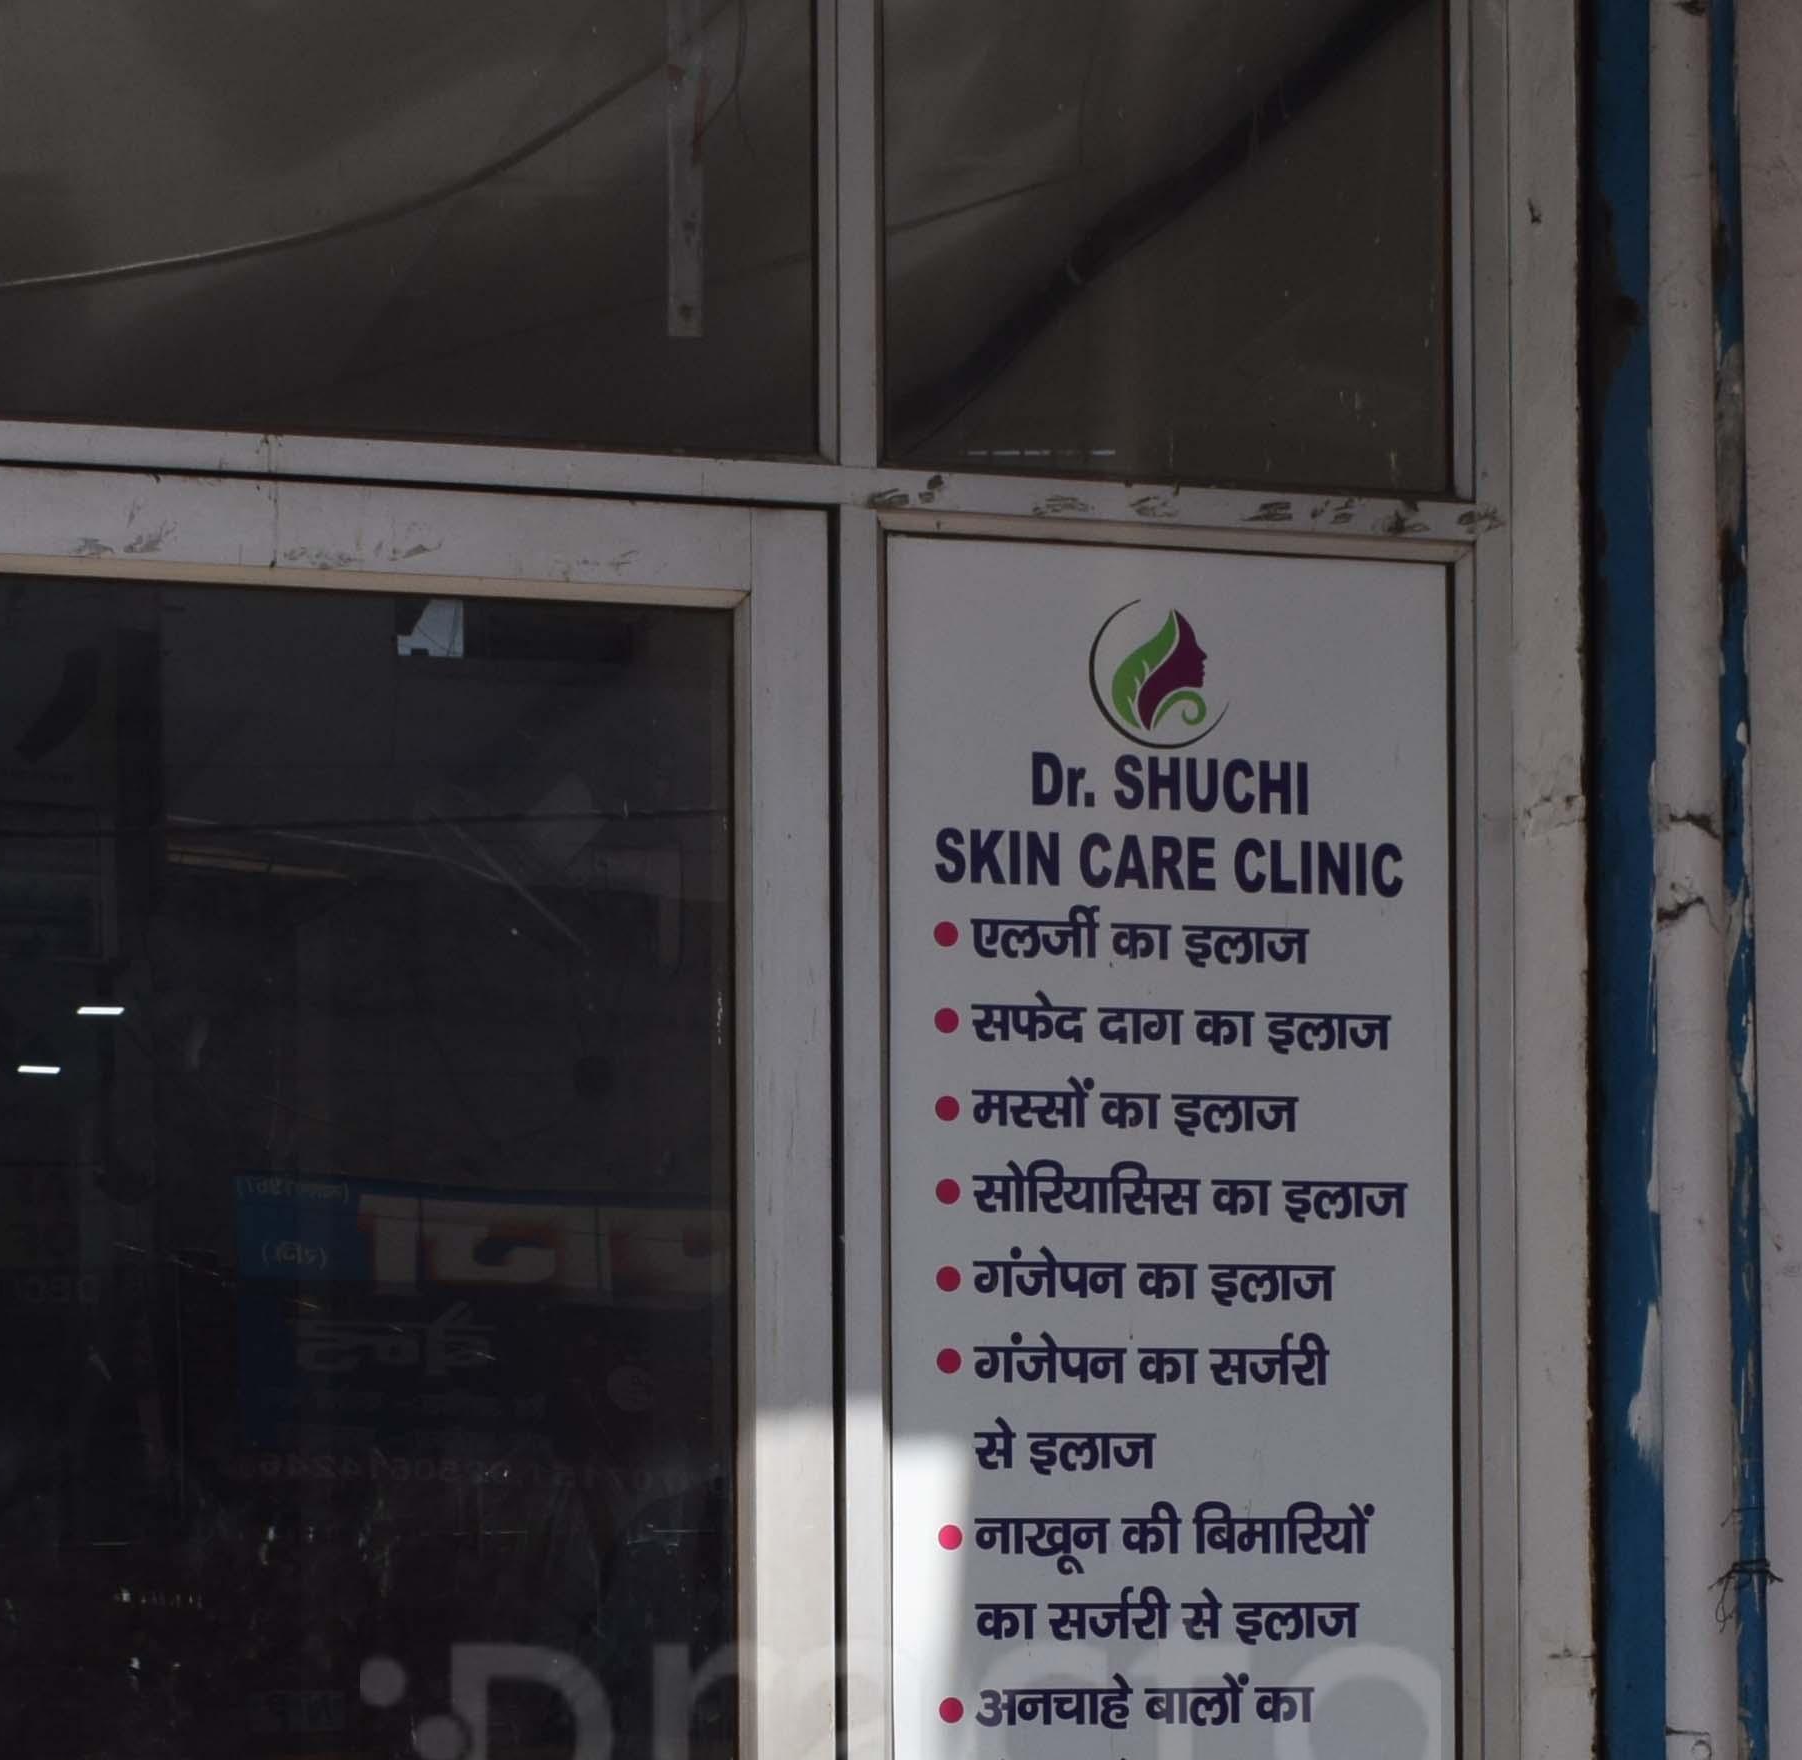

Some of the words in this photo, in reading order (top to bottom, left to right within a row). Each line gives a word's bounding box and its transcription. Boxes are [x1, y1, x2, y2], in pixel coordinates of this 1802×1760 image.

[1032, 752, 1095, 807] Dr.
[1115, 755, 1308, 815] SHUCHI
[935, 828, 1059, 886] SKIN
[1080, 833, 1216, 891] CARE
[1235, 838, 1403, 897] CLINIC
[970, 905, 1100, 958] एलर्जी
[1111, 923, 1171, 960] का
[1182, 925, 1309, 968] इलाज
[971, 990, 1087, 1043] सफेद
[1098, 1008, 1184, 1045] दाग
[1194, 1010, 1255, 1047] का
[1265, 1012, 1391, 1054] इलाज
[972, 1076, 1094, 1128] मस्सों
[1100, 1093, 1161, 1129] का
[1171, 1094, 1299, 1137] इलाज
[972, 1159, 1201, 1216] सोरियासिस
[1211, 1180, 1272, 1216] का
[1282, 1181, 1408, 1223] इलाज
[973, 1246, 1126, 1298] गंजेपन
[1137, 1263, 1198, 1299] का
[1208, 1264, 1335, 1306] इलाज
[974, 1331, 1127, 1384] गंजेपन
[1138, 1348, 1198, 1384] का
[1209, 1333, 1330, 1386] सर्जरी
[974, 1417, 1016, 1470] से
[1027, 1433, 1156, 1475] इलाज
[975, 1518, 1110, 1575] नाखून
[1121, 1501, 1182, 1554] की
[1193, 1501, 1374, 1555] बिमारियों
[975, 1604, 1037, 1640] का
[1048, 1586, 1171, 1640] सर्जरी
[1181, 1588, 1222, 1640] से
[1233, 1602, 1360, 1645] इलाज
[976, 1673, 1133, 1729] अनचाहे
[1144, 1672, 1249, 1726] बालों
[1254, 1687, 1314, 1723] का
